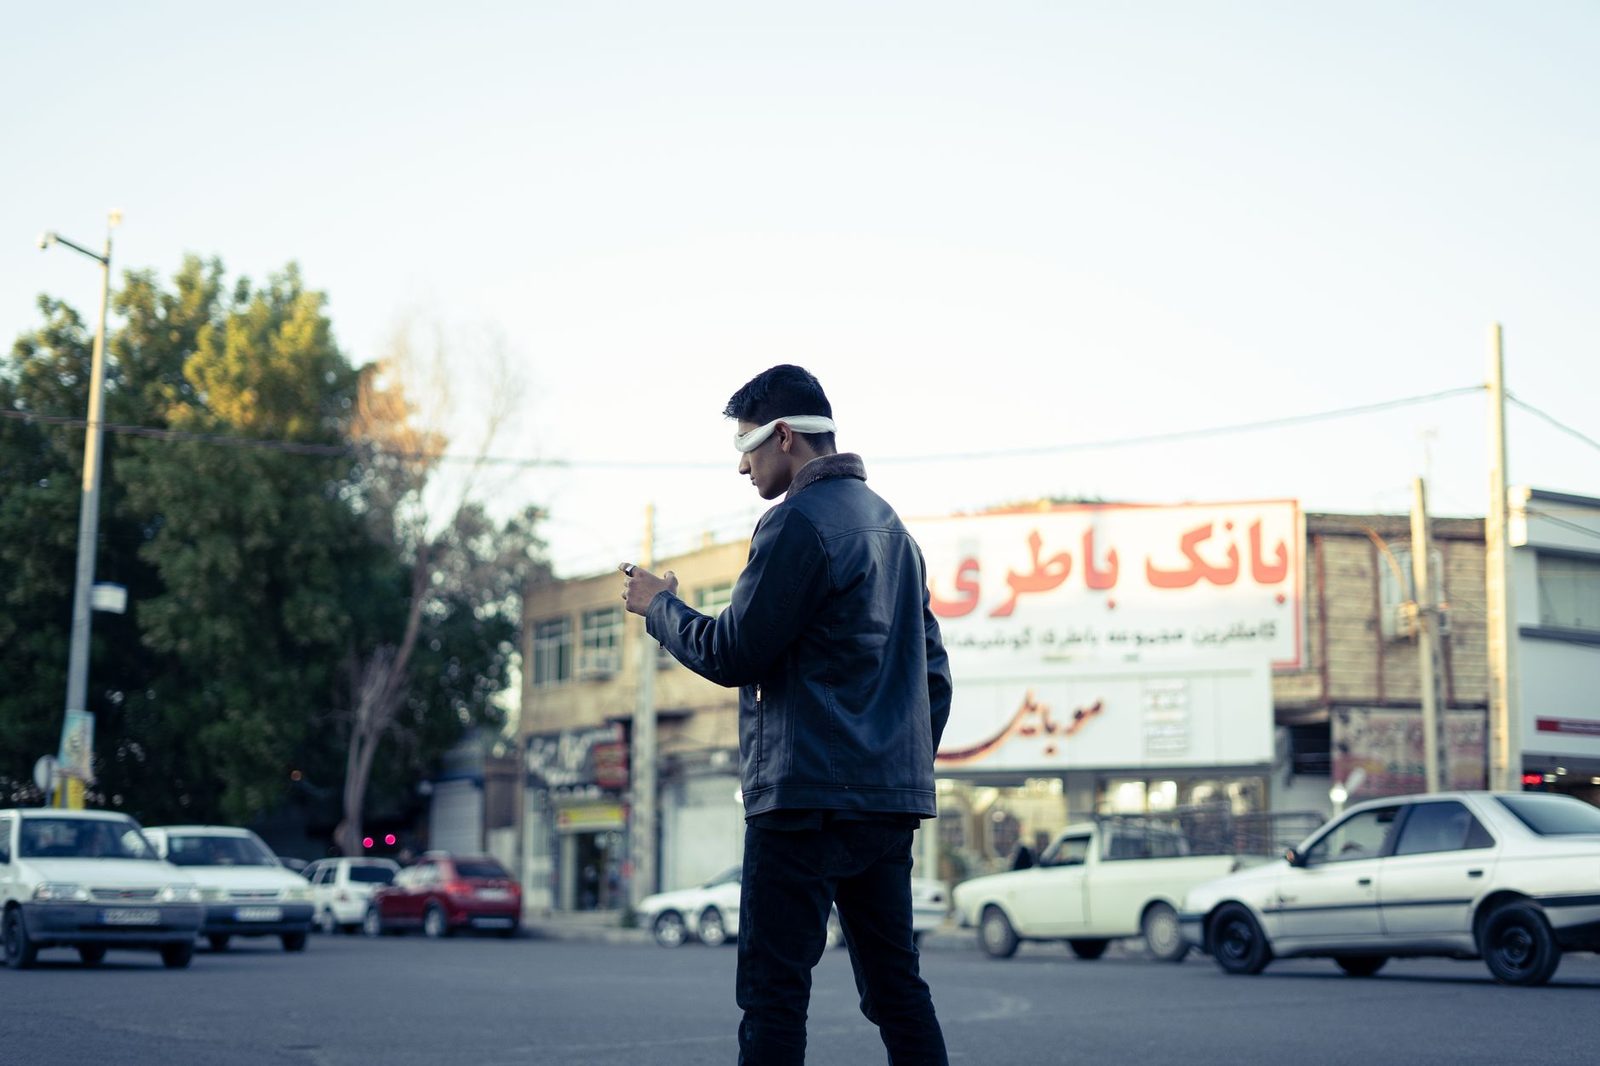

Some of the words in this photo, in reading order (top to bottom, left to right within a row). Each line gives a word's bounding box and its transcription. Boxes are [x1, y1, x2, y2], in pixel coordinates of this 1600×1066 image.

[929, 527, 1119, 618] باطری
[1146, 519, 1288, 605] بانک
[933, 689, 1105, 763] موبایل
